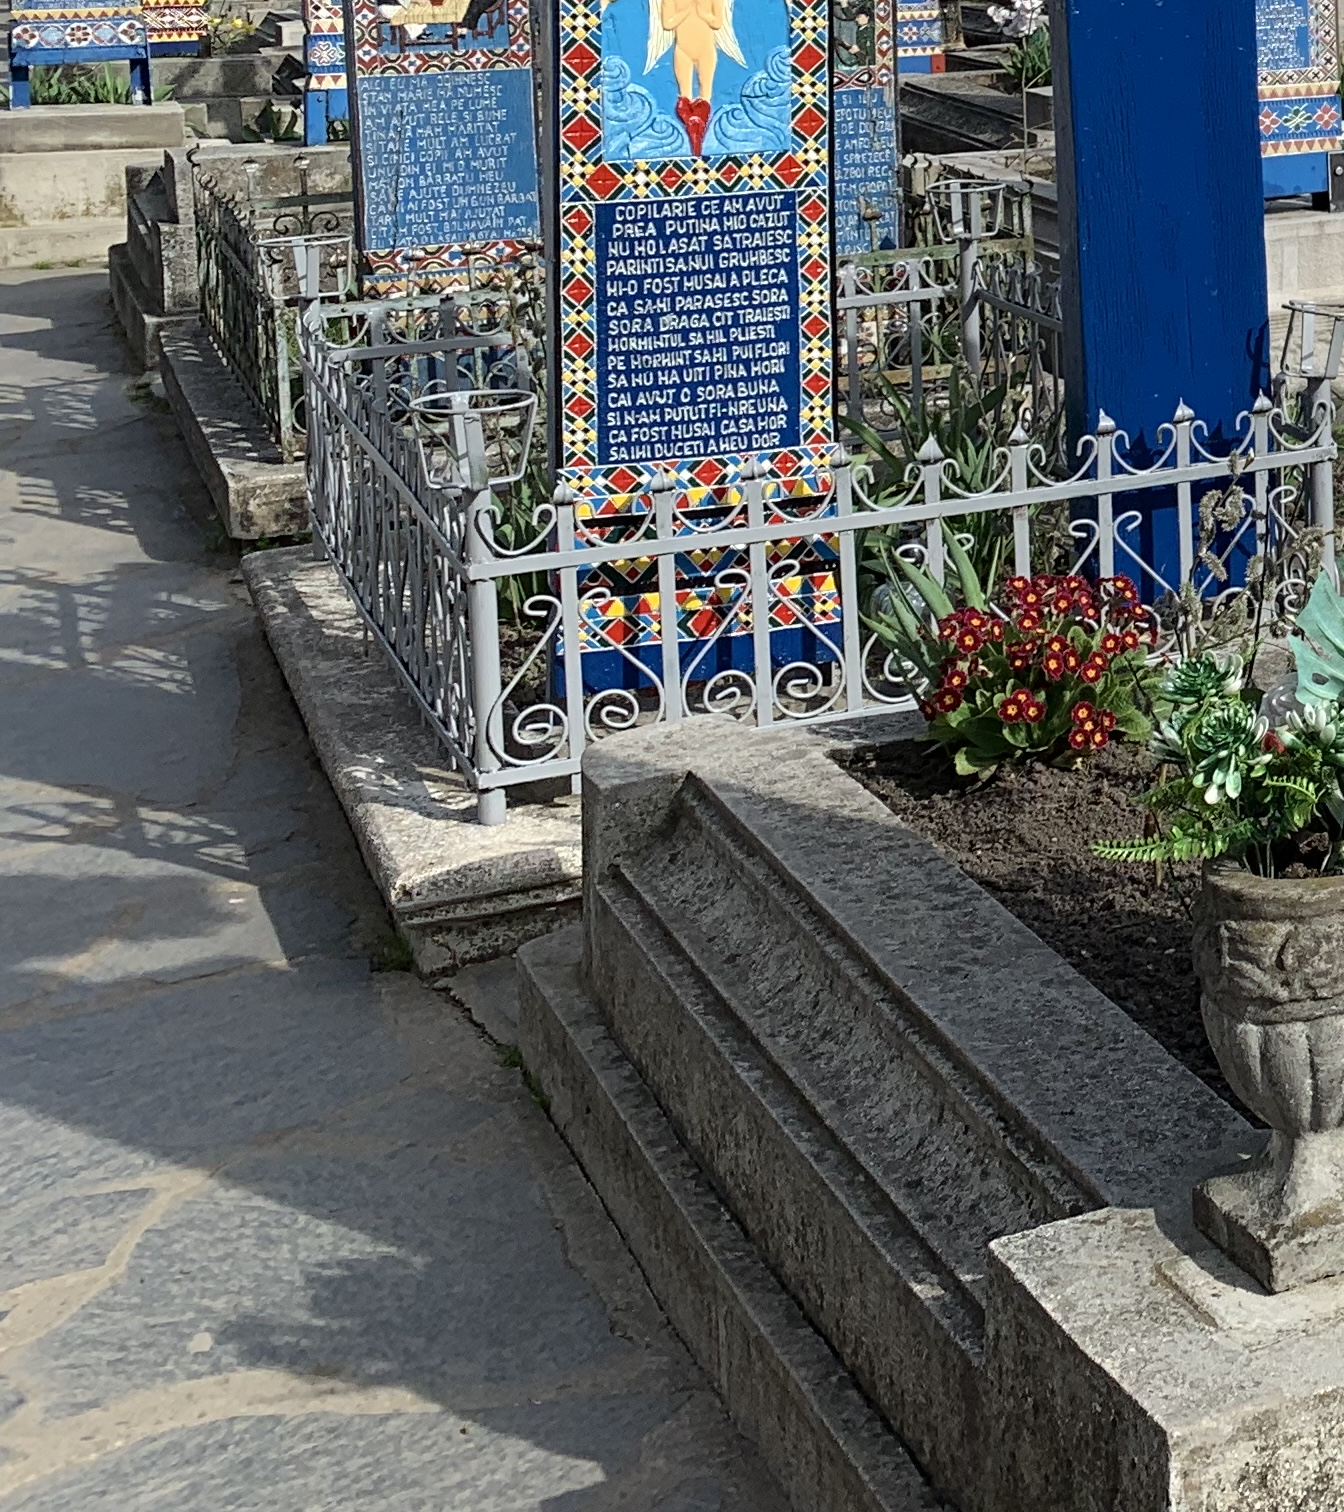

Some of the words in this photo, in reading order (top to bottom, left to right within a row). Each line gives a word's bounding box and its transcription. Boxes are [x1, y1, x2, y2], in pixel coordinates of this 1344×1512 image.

[390, 78, 405, 89] EU
[397, 88, 433, 101] MARIE
[451, 99, 464, 110] PE
[477, 145, 508, 158] AVUT
[409, 185, 446, 199] AJUTE
[422, 197, 450, 210] FOST
[615, 201, 697, 221] COPILARIE
[701, 199, 720, 215] CE
[745, 195, 784, 211] AVUT
[406, 211, 435, 224] MULT
[612, 222, 657, 238] PREA
[750, 211, 790, 228] CAZUT
[660, 236, 708, 254] LASAT
[643, 277, 680, 294] FOST
[730, 272, 740, 287] A
[742, 267, 788, 286] PLECA
[607, 301, 629, 317] CA
[675, 292, 749, 311] PARASESC
[751, 287, 789, 304] SORA
[608, 318, 654, 335] SORA
[659, 313, 710, 332] DRAGA
[712, 311, 734, 327] CIT
[607, 355, 626, 370] PE
[755, 341, 791, 359] FLORI
[607, 373, 629, 388] SA
[608, 392, 632, 408] CAI
[680, 387, 691, 403] O
[697, 384, 735, 402] SORA
[607, 412, 621, 426] SI
[608, 430, 627, 444] CA
[631, 426, 668, 442] FOST
[752, 432, 780, 448] DOR
